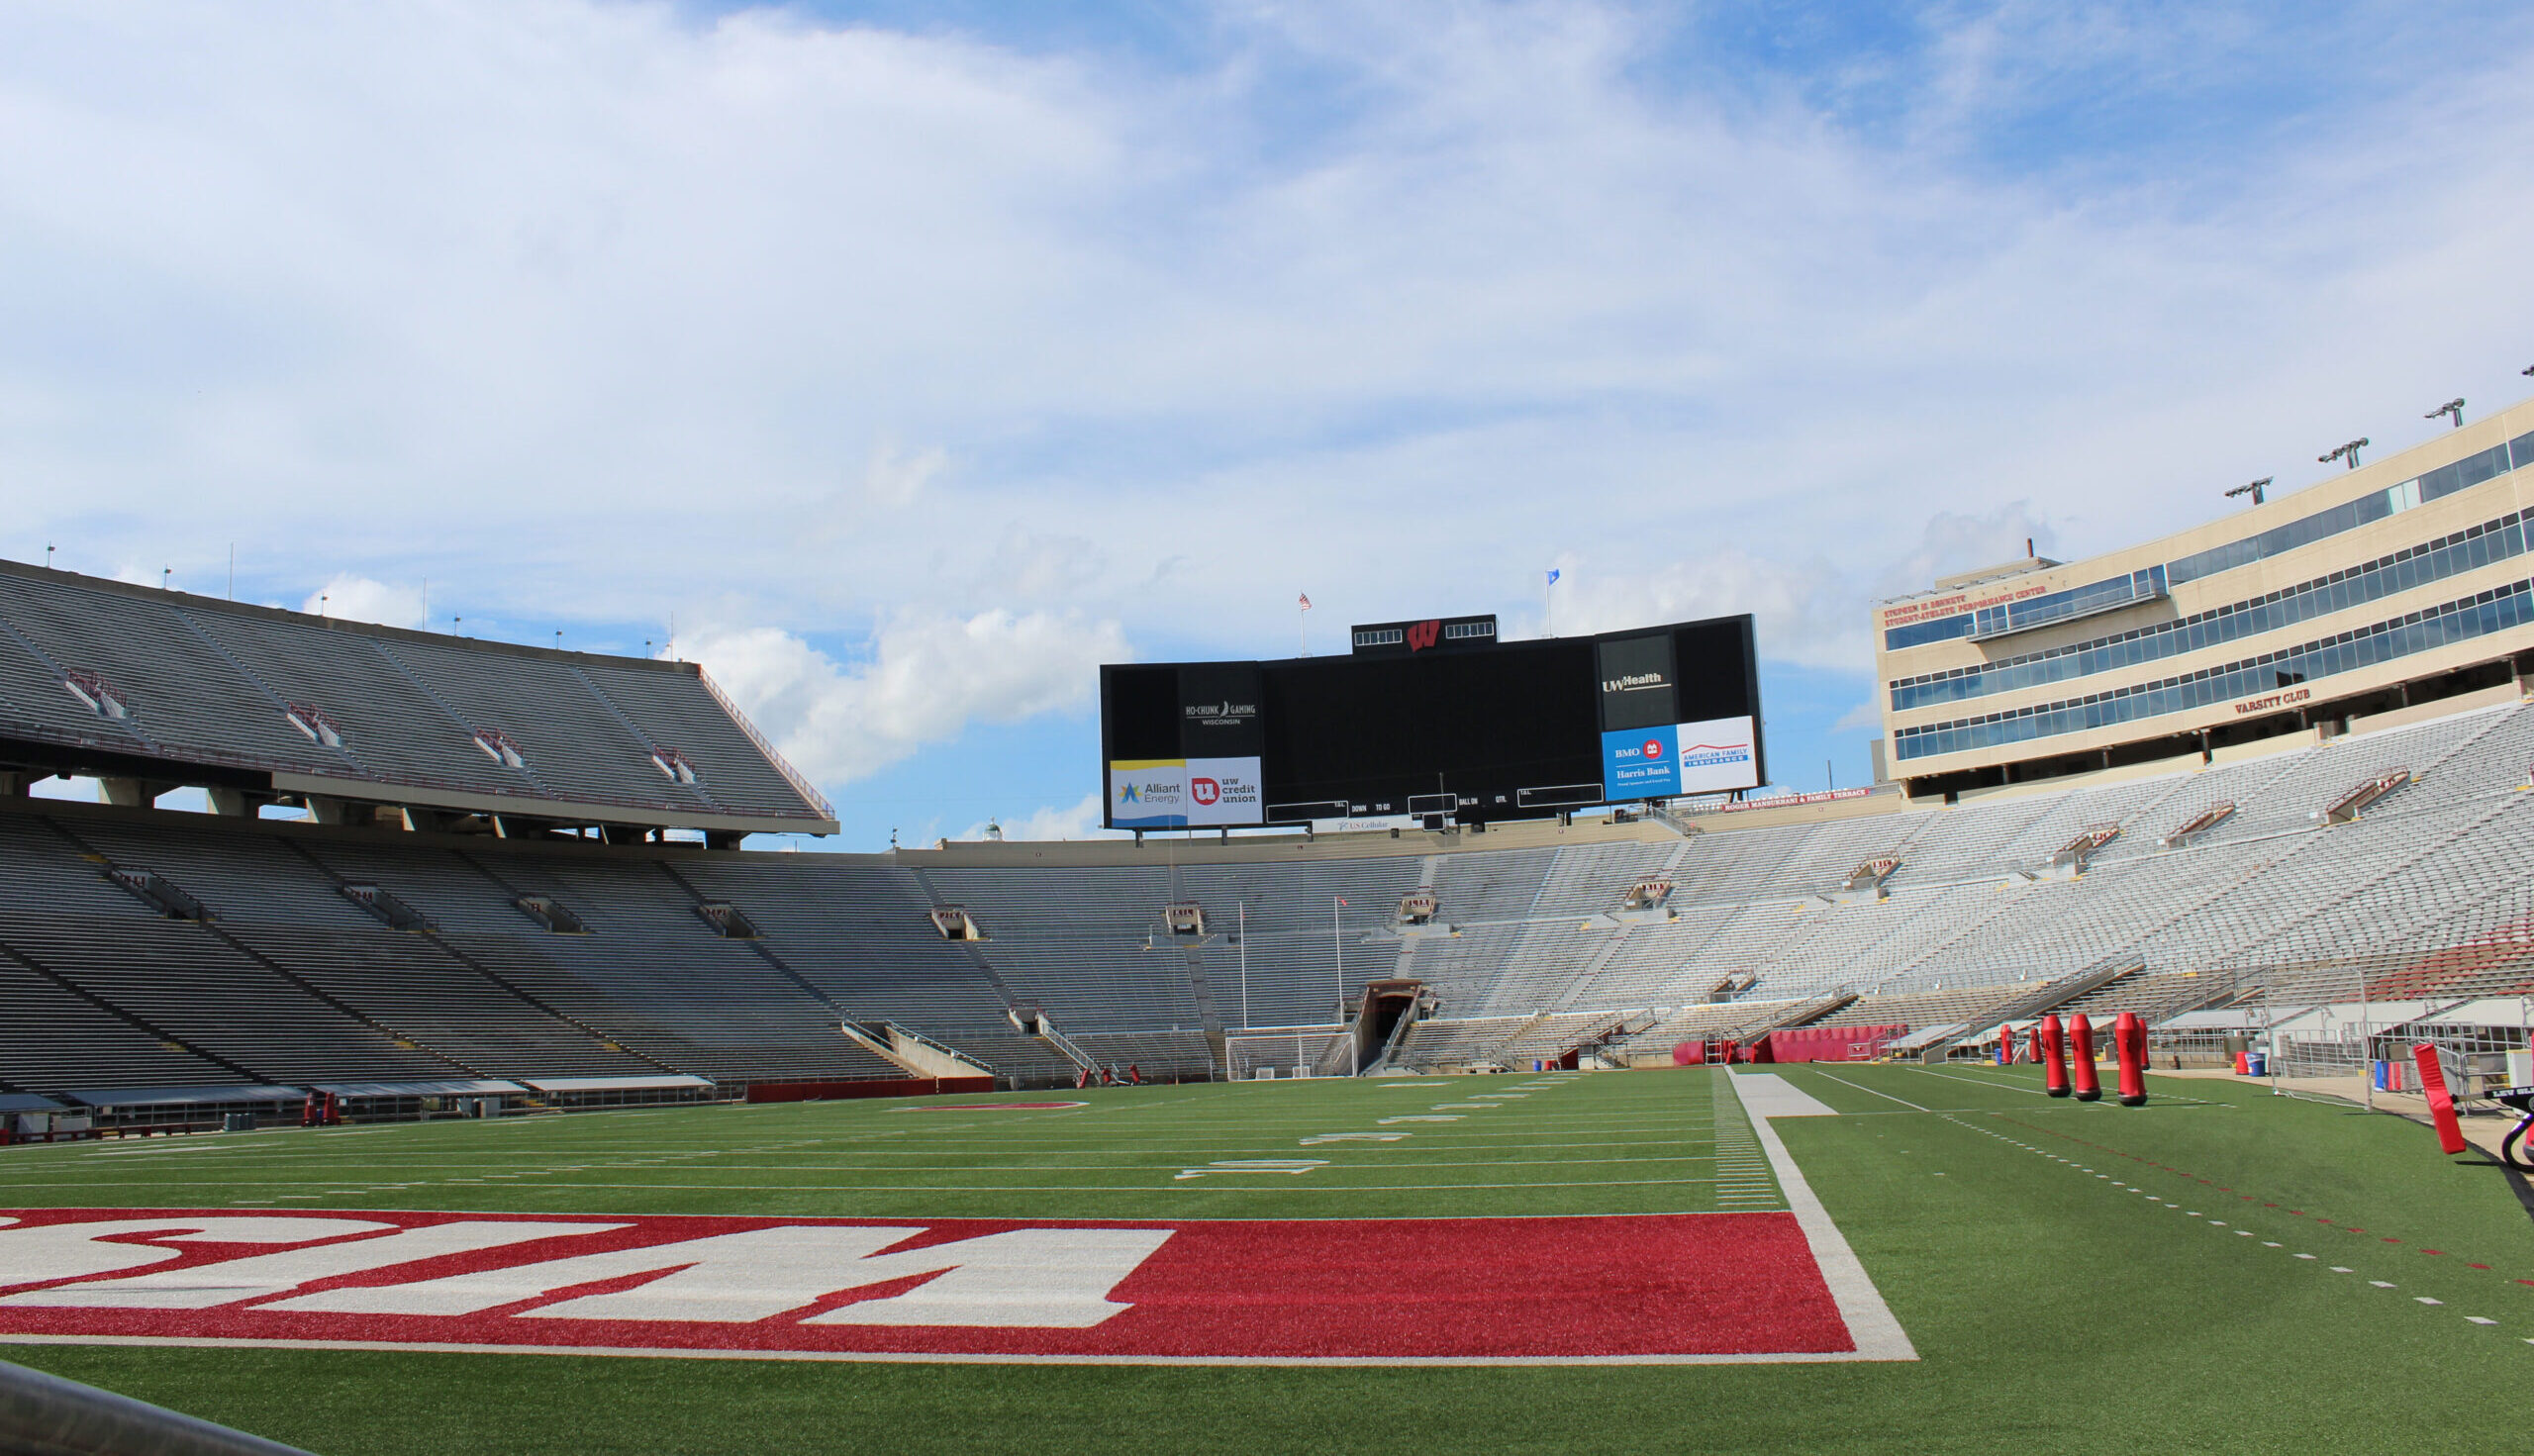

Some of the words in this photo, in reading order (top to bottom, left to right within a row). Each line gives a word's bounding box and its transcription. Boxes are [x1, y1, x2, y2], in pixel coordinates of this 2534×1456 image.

[1959, 594, 2014, 613] PERFORMANCE
[2015, 586, 2046, 600] CENTER
[1885, 605, 1918, 619] STEPHEN
[1930, 594, 1966, 609] BENNETT
[1408, 620, 1440, 652] W
[2235, 695, 2282, 714] VARSITY
[2284, 689, 2311, 704] CLUB
[1186, 705, 1218, 715] HO-CHUNK
[1230, 704, 1255, 714] GAMING
[1615, 747, 1640, 759] BMO
[1684, 750, 1720, 760] AMERICAN
[1722, 747, 1748, 756] FAMILY
[1688, 755, 1744, 766] INSURANCE
[1616, 768, 1645, 779] Harris
[1646, 765, 1671, 776] Bank
[1145, 783, 1180, 794] Alliant
[1221, 785, 1256, 794] credit
[1145, 794, 1180, 804] Energy
[1222, 795, 1256, 804] union
[1725, 802, 1749, 812] ROGER
[1806, 793, 1831, 803] FAMILY
[1833, 789, 1866, 799] TERRACE
